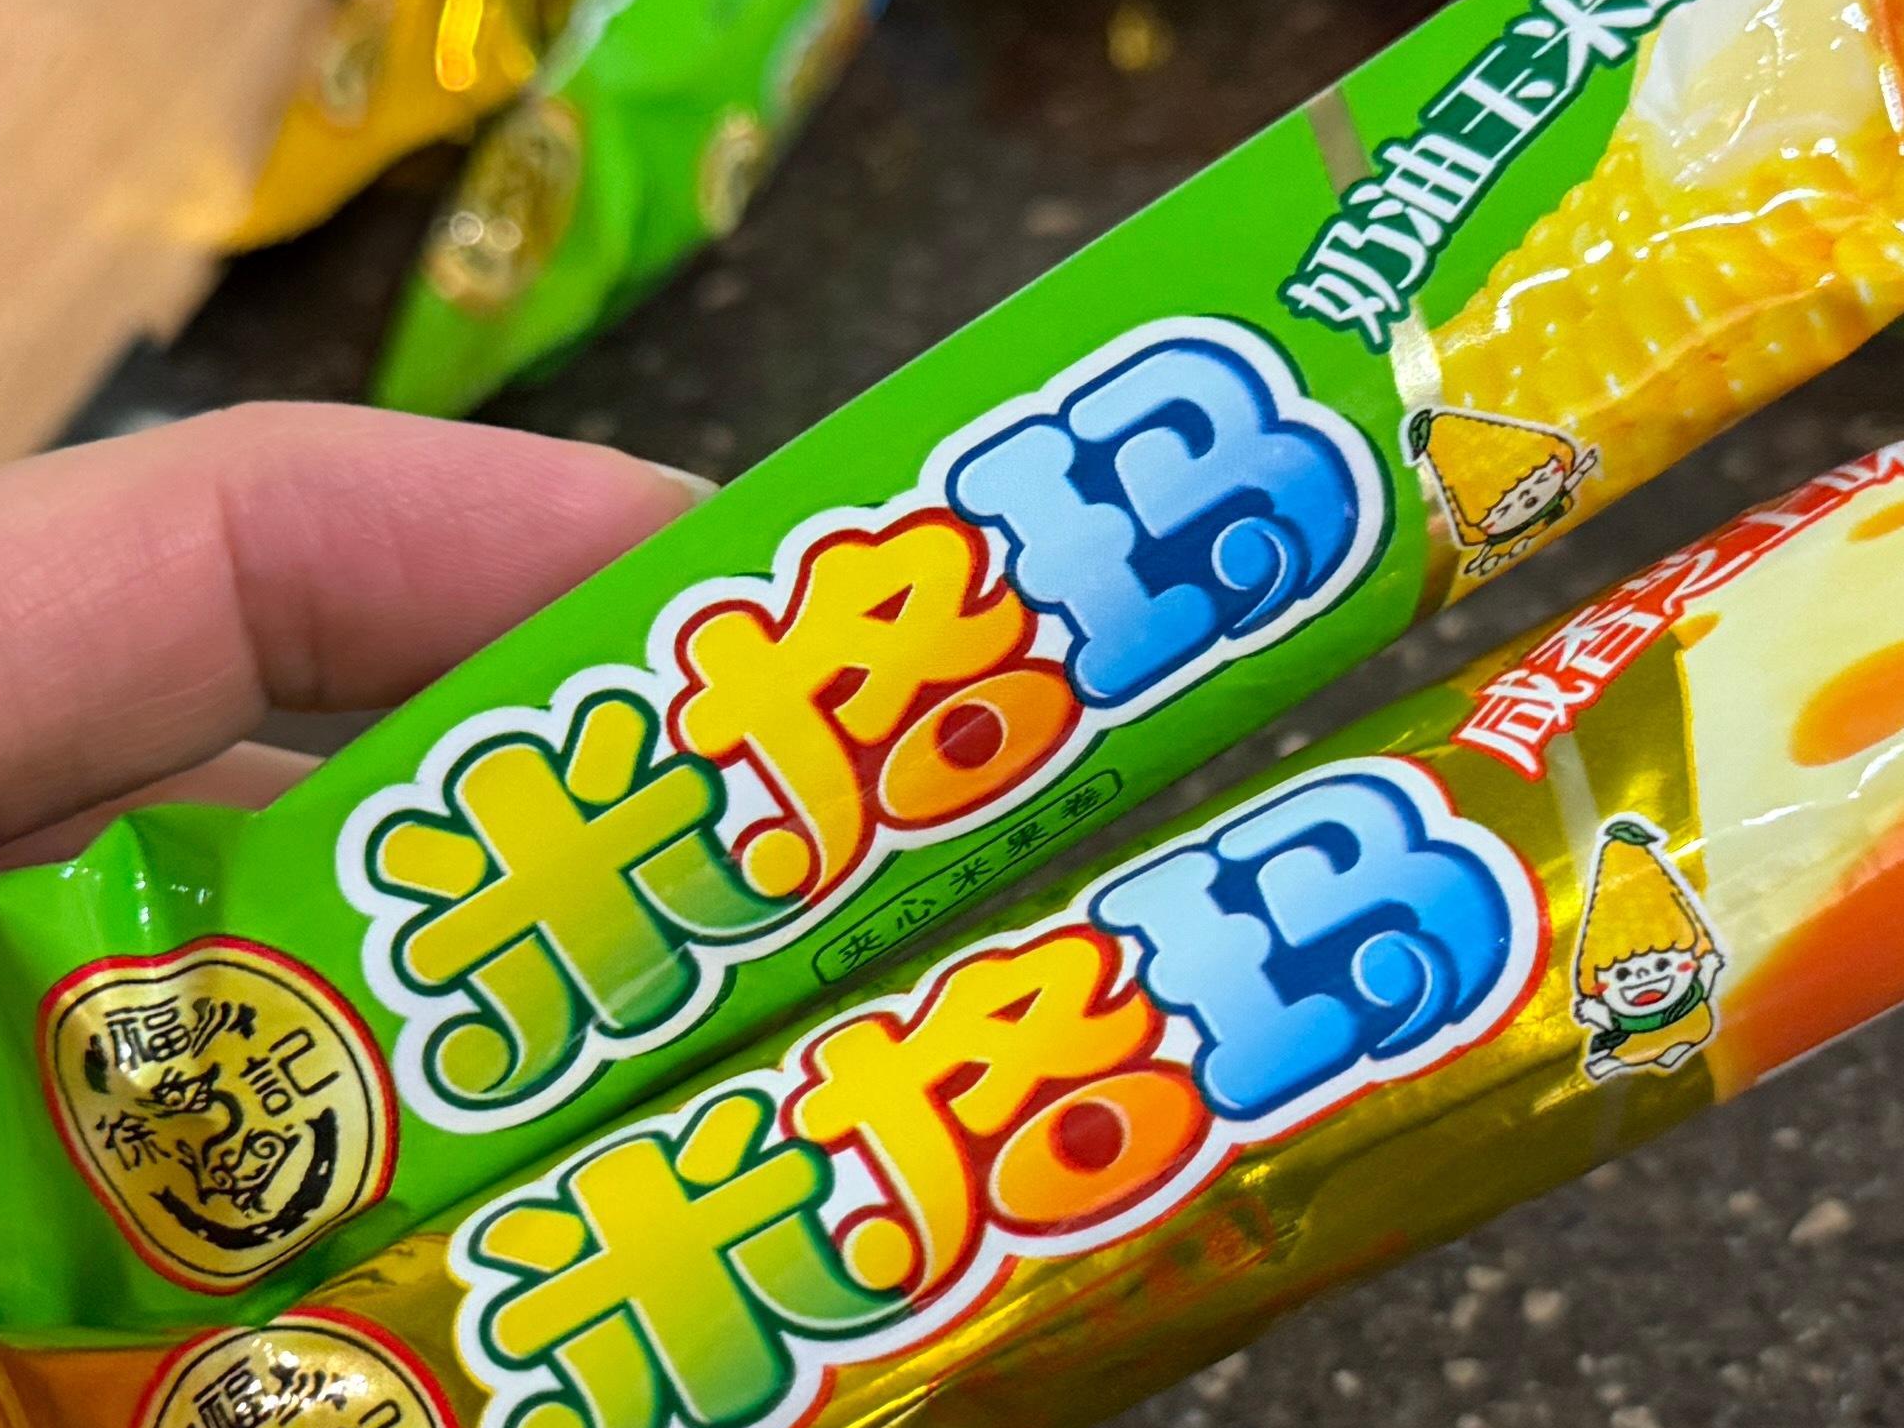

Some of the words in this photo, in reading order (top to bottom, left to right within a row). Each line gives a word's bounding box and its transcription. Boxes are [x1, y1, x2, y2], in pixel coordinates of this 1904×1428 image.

[839, 783, 1106, 963] 夹心米果卷
